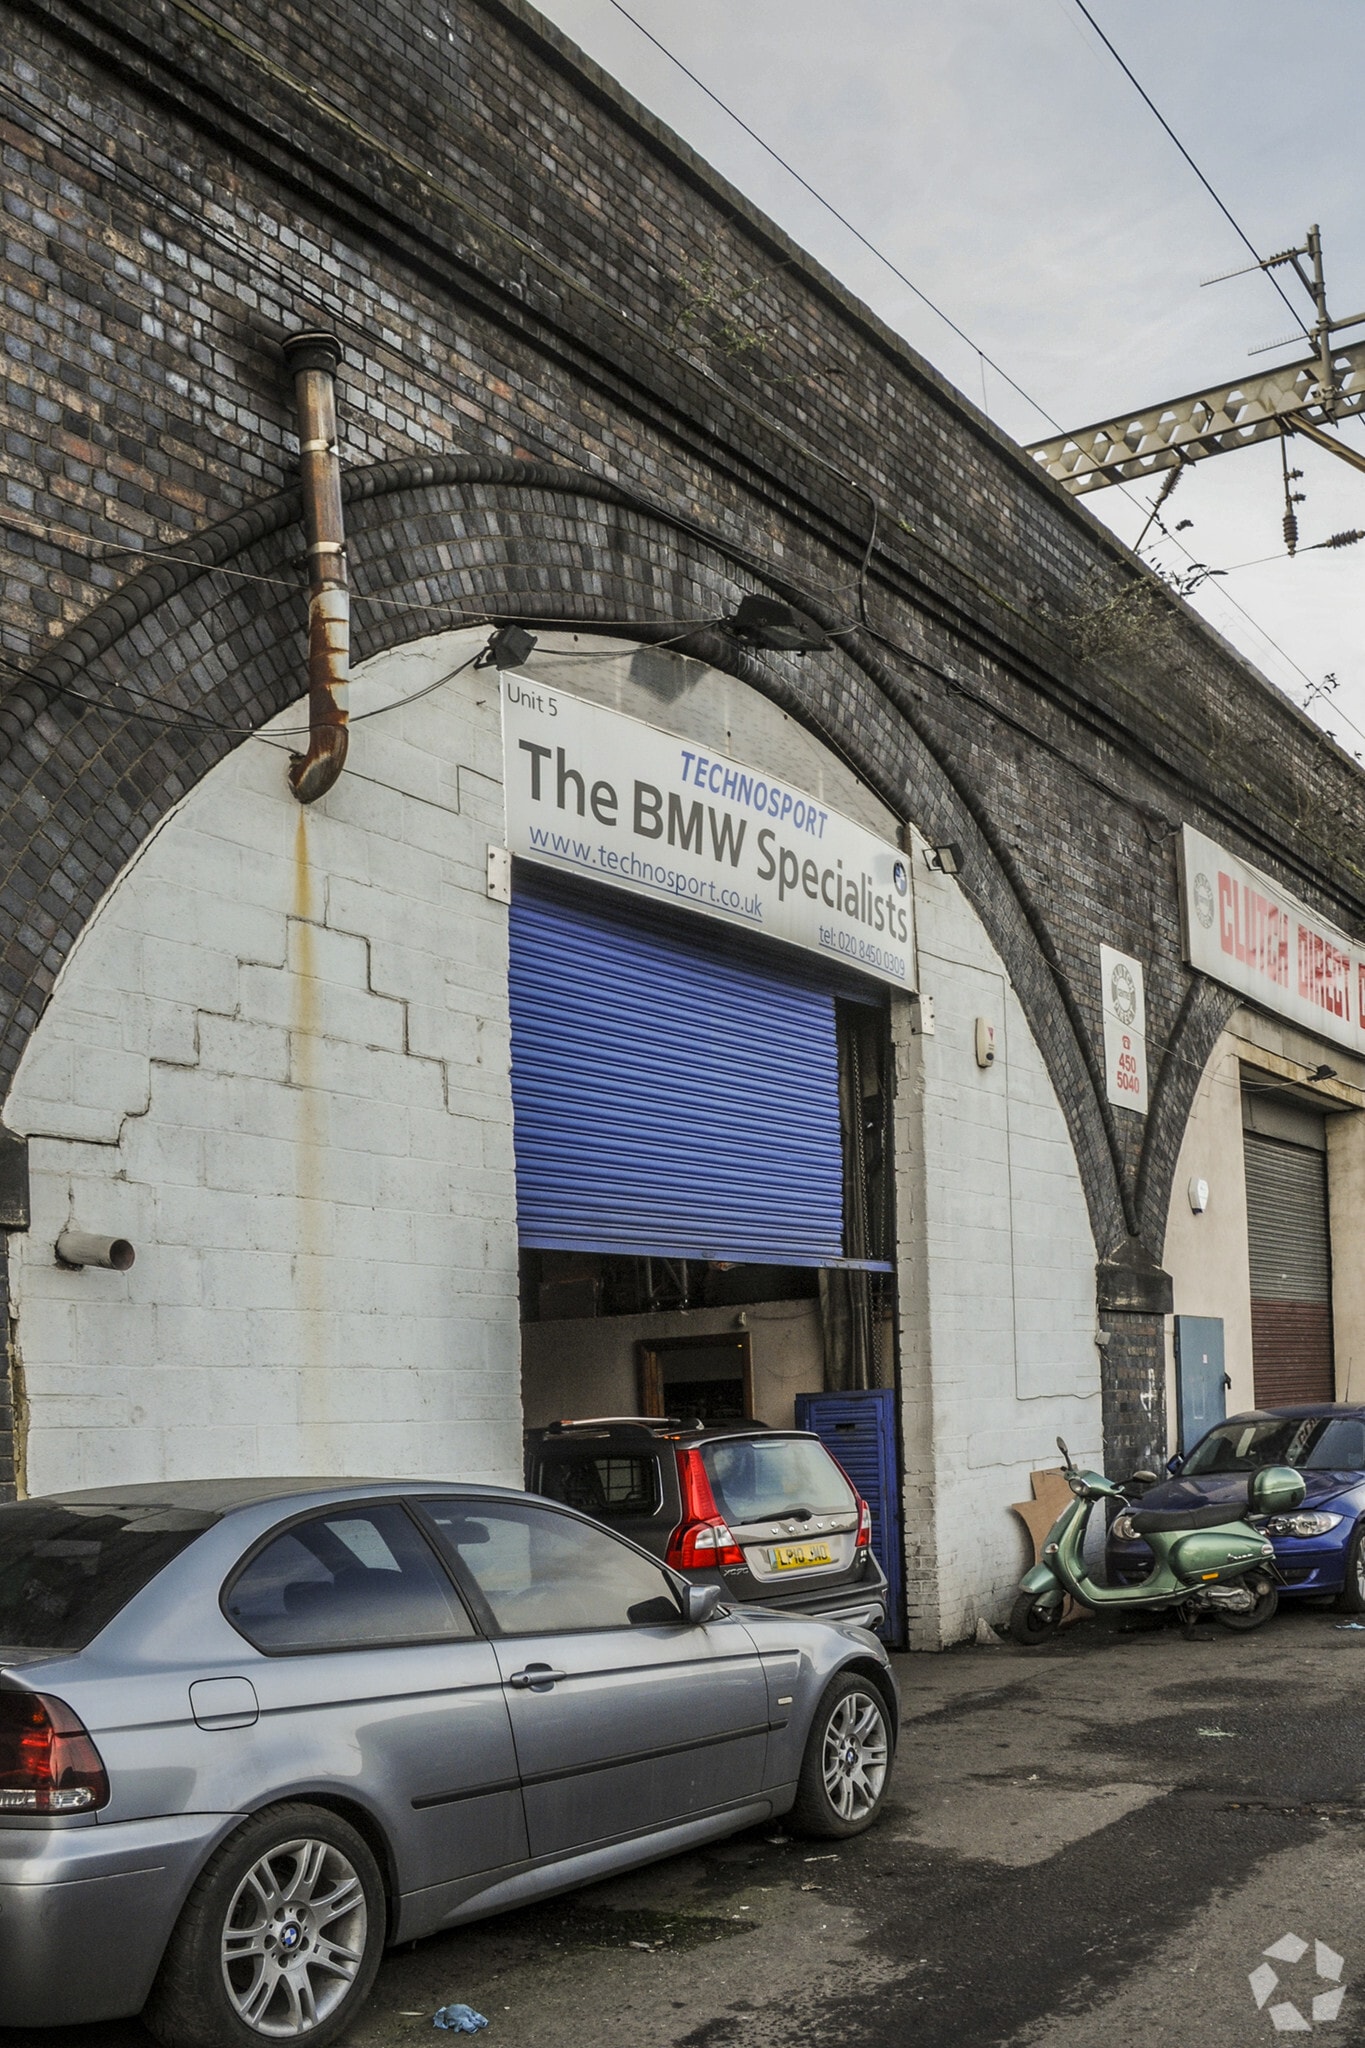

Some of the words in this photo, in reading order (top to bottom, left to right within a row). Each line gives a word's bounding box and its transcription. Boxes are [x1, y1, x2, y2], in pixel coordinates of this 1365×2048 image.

[507, 683, 544, 713] Unit
[549, 698, 558, 717] 5
[681, 751, 829, 839] TECHNOSPORT
[518, 738, 619, 828] The
[633, 779, 748, 868] BMW
[756, 828, 908, 943] Specialists
[529, 826, 763, 917] www.technosport.co.uk
[819, 925, 836, 946] tel:
[838, 931, 857, 955] 020
[859, 940, 882, 966] 8450
[884, 951, 905, 976] 0309
[1218, 871, 1289, 988] CLUTCH
[1298, 923, 1350, 1021] DIRECT
[1117, 1070, 1140, 1094] 5040
[1119, 1053, 1136, 1073] 450
[770, 1520, 837, 1535] VOLVO
